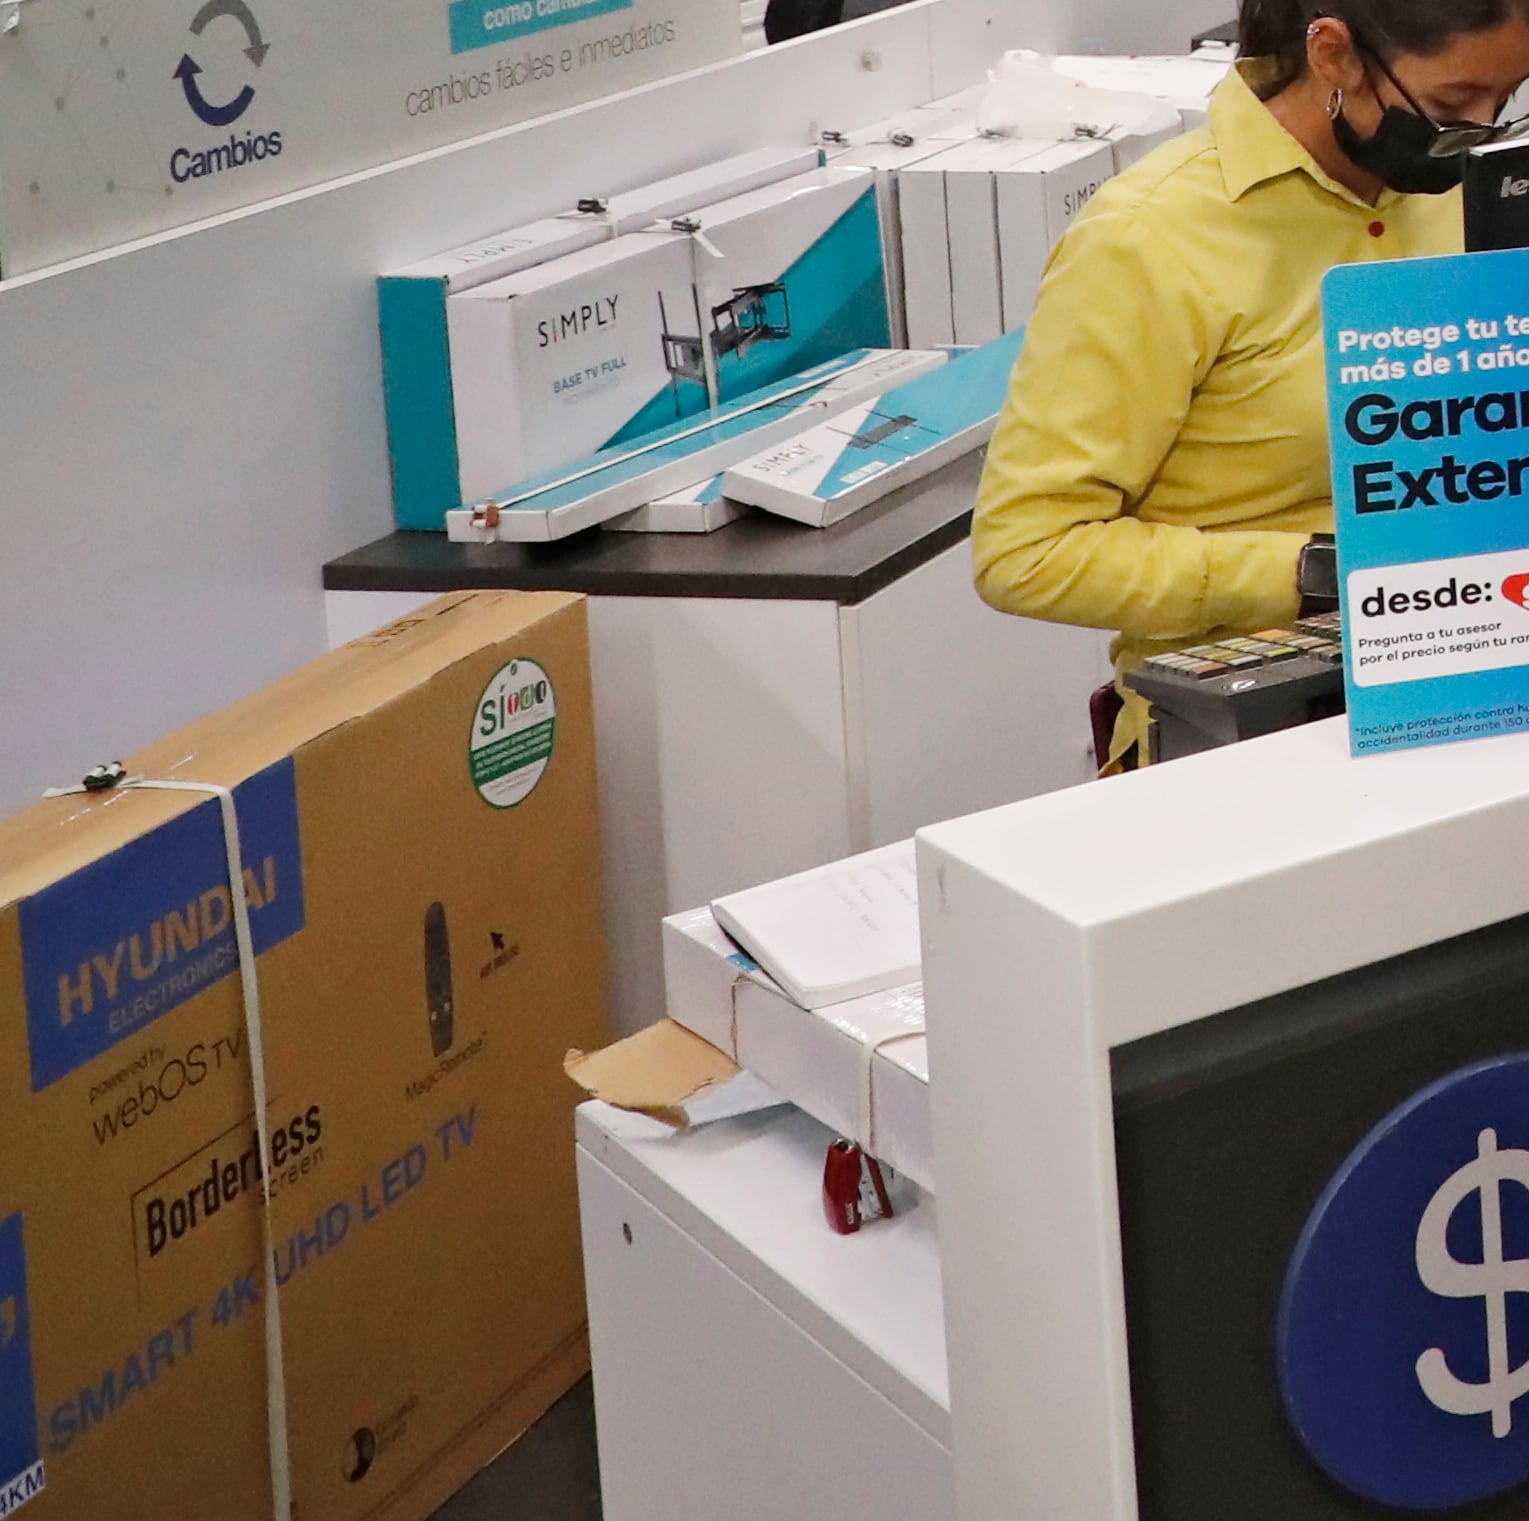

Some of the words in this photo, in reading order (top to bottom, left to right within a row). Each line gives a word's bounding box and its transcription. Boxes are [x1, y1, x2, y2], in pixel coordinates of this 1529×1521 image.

[483, 0, 532, 31] como
[405, 70, 491, 117] cambios
[496, 53, 554, 90] fáciles
[560, 48, 572, 73] e
[578, 19, 675, 67] inmediatos
[170, 128, 282, 184] Cambios
[537, 293, 619, 348] SIMPLY
[1337, 324, 1460, 353] Protege
[1465, 317, 1499, 341] tu
[552, 371, 582, 394] BASE
[584, 366, 599, 380] TV
[600, 355, 628, 376] FULL
[1340, 355, 1406, 385] más
[1413, 351, 1451, 378] de
[1457, 349, 1471, 373] 1
[1361, 577, 1493, 618] desde:
[1358, 631, 1424, 649] Pregunta
[1426, 630, 1436, 640] a
[1438, 626, 1454, 639] tu
[1456, 621, 1502, 636] asesor
[1358, 653, 1384, 667] por
[1386, 648, 1399, 662] el
[1401, 643, 1447, 661] precio
[1448, 637, 1491, 655] según
[1492, 633, 1509, 647] tu
[1357, 727, 1451, 750] accidentalidad
[1453, 719, 1501, 736] durante
[1503, 713, 1524, 728] 150
[1406, 711, 1472, 732] protección
[1474, 705, 1515, 721] contra
[57, 855, 278, 1027] HYUNDAI
[109, 941, 239, 1033] ELECTRONICS
[93, 1043, 207, 1145] webOS
[212, 1034, 242, 1066] TV
[258, 1146, 325, 1204] screen
[49, 1306, 200, 1455] SMART
[210, 1271, 260, 1330] 4K
[272, 1200, 352, 1286] UHD
[361, 1142, 428, 1222] LED
[434, 1103, 477, 1162] TV
